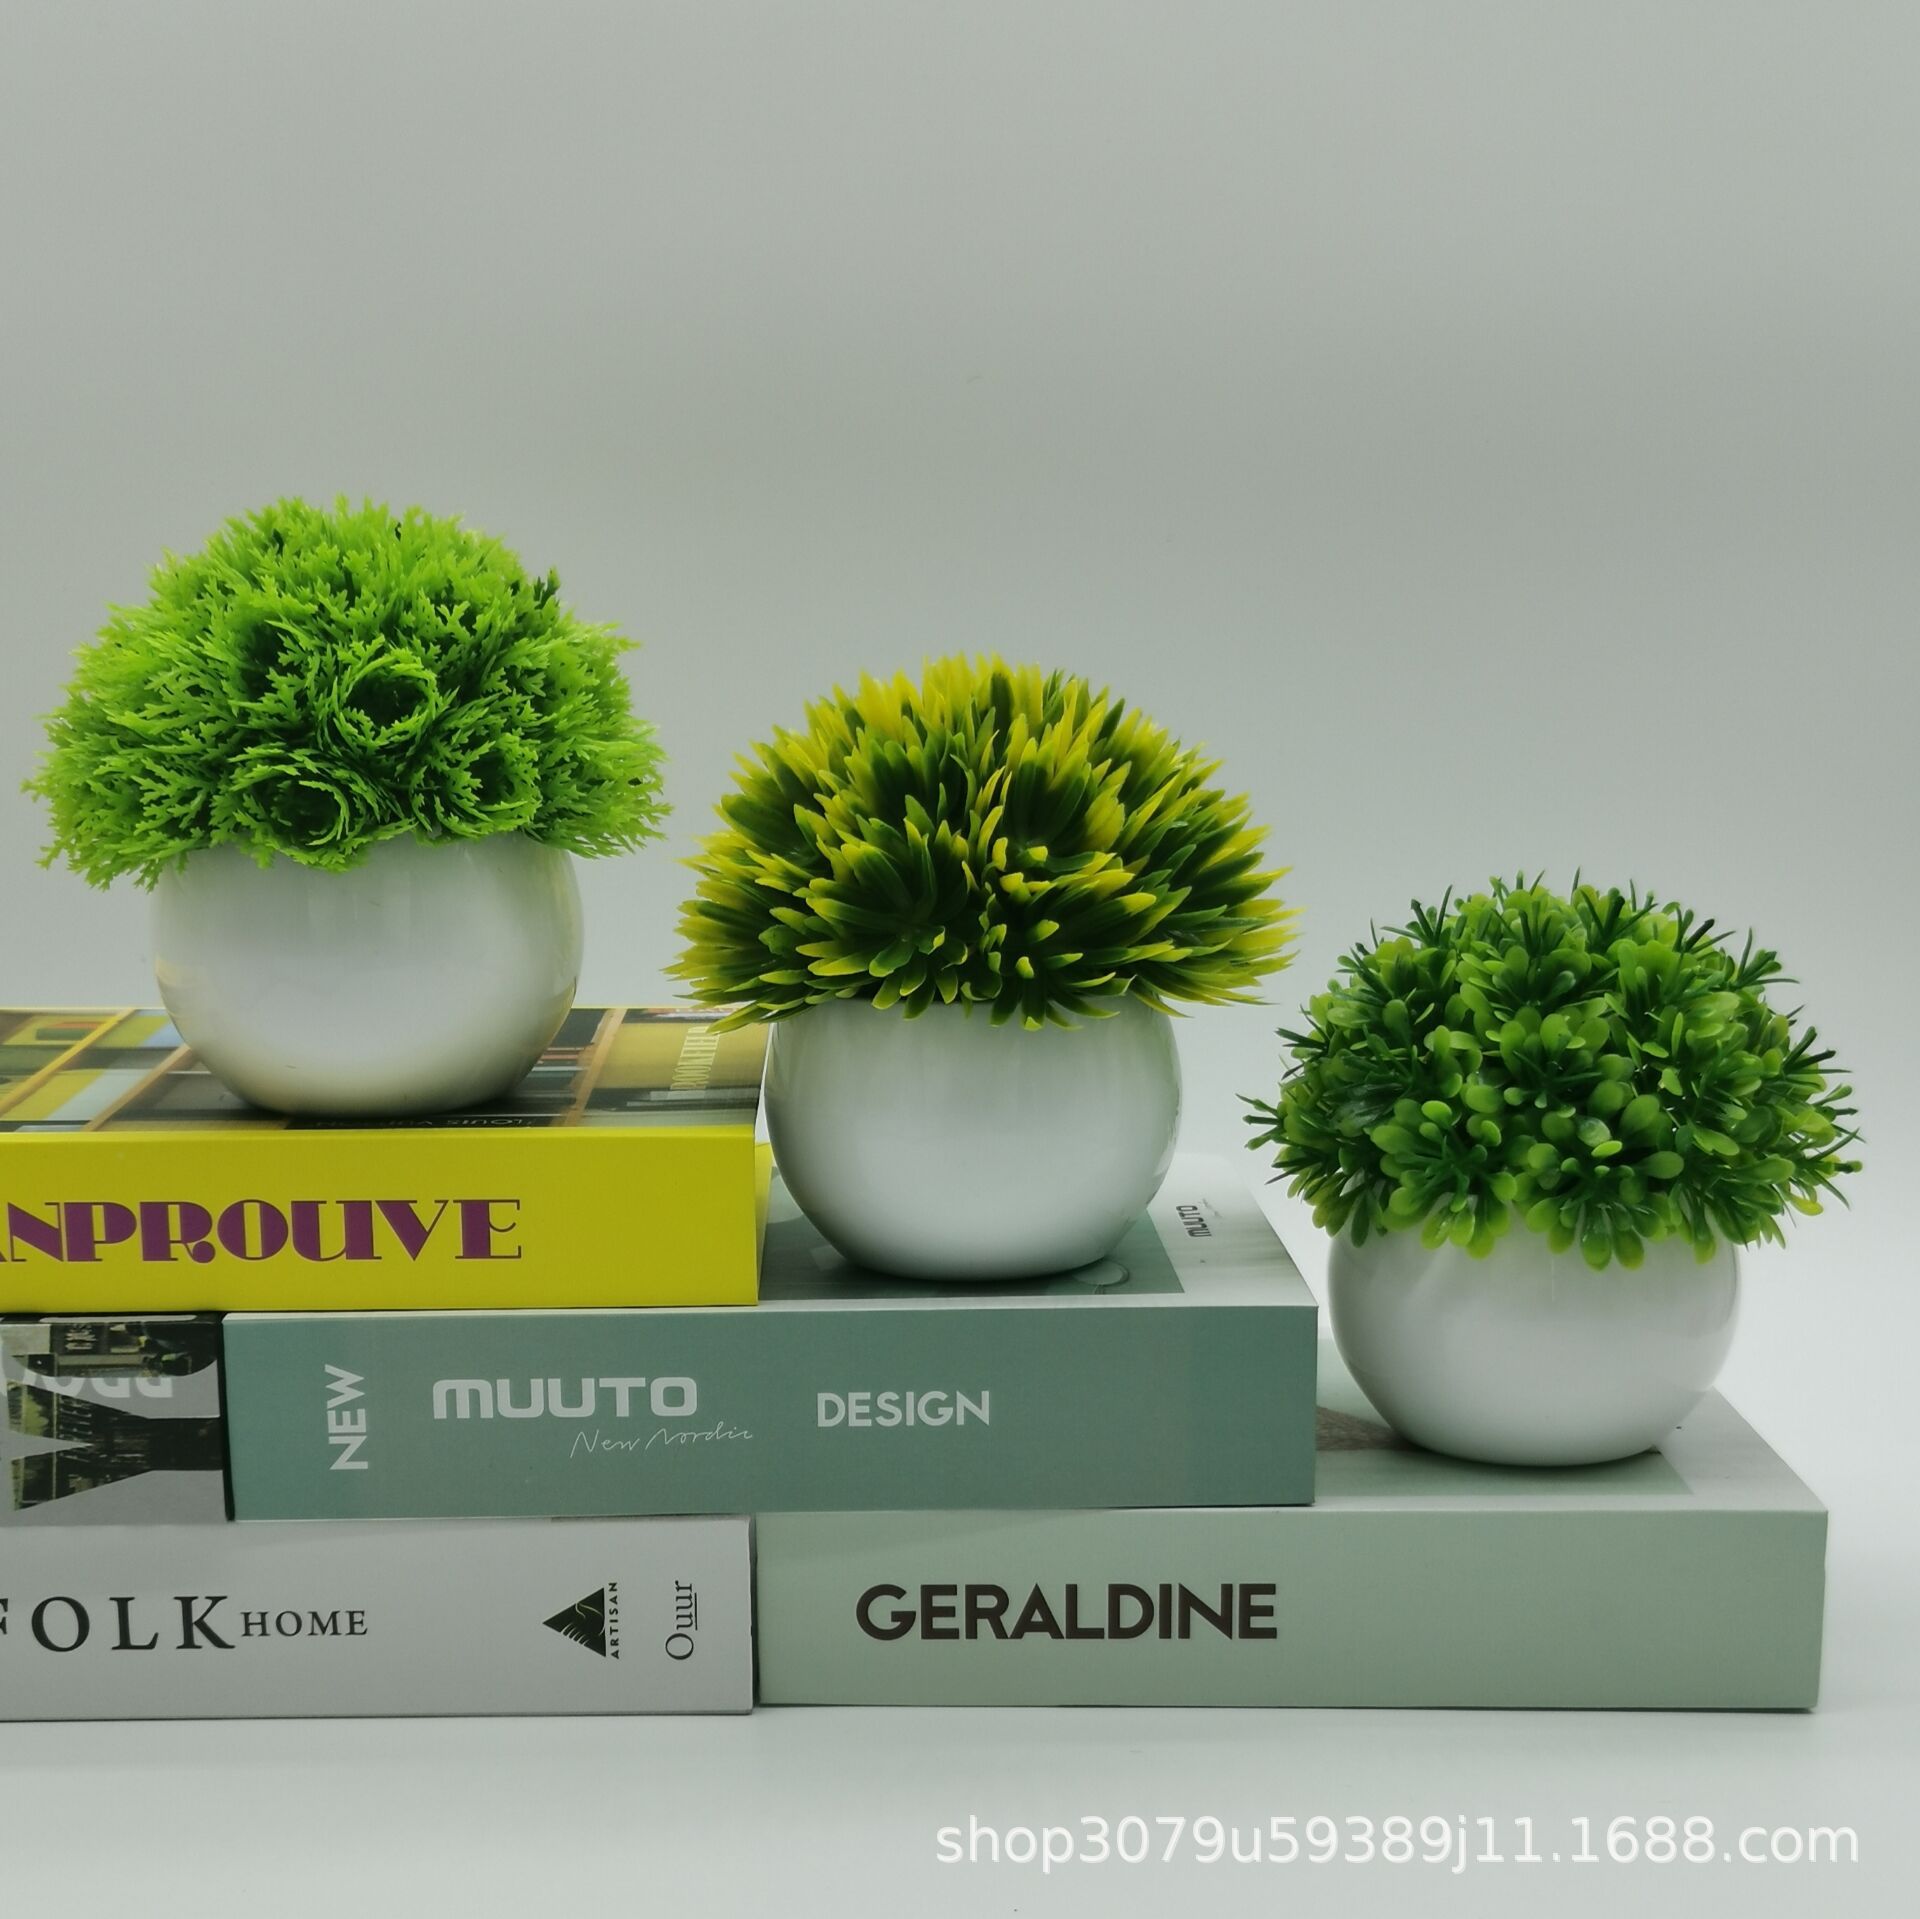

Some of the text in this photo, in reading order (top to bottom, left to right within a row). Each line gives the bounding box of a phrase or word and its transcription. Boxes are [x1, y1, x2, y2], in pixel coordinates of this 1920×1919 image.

[0, 1198, 522, 1263] NPROUVE
[1175, 1204, 1213, 1238] MUUTO
[325, 1363, 369, 1470] NEW
[432, 1376, 698, 1420] MUUTO
[817, 1390, 990, 1428] DESIGN
[569, 1420, 753, 1459] New Nordic
[240, 1609, 368, 1638] HOME
[608, 1582, 620, 1660] ARTISAN
[665, 1580, 698, 1660] Ouur
[856, 1582, 1278, 1641] GERALDINE
